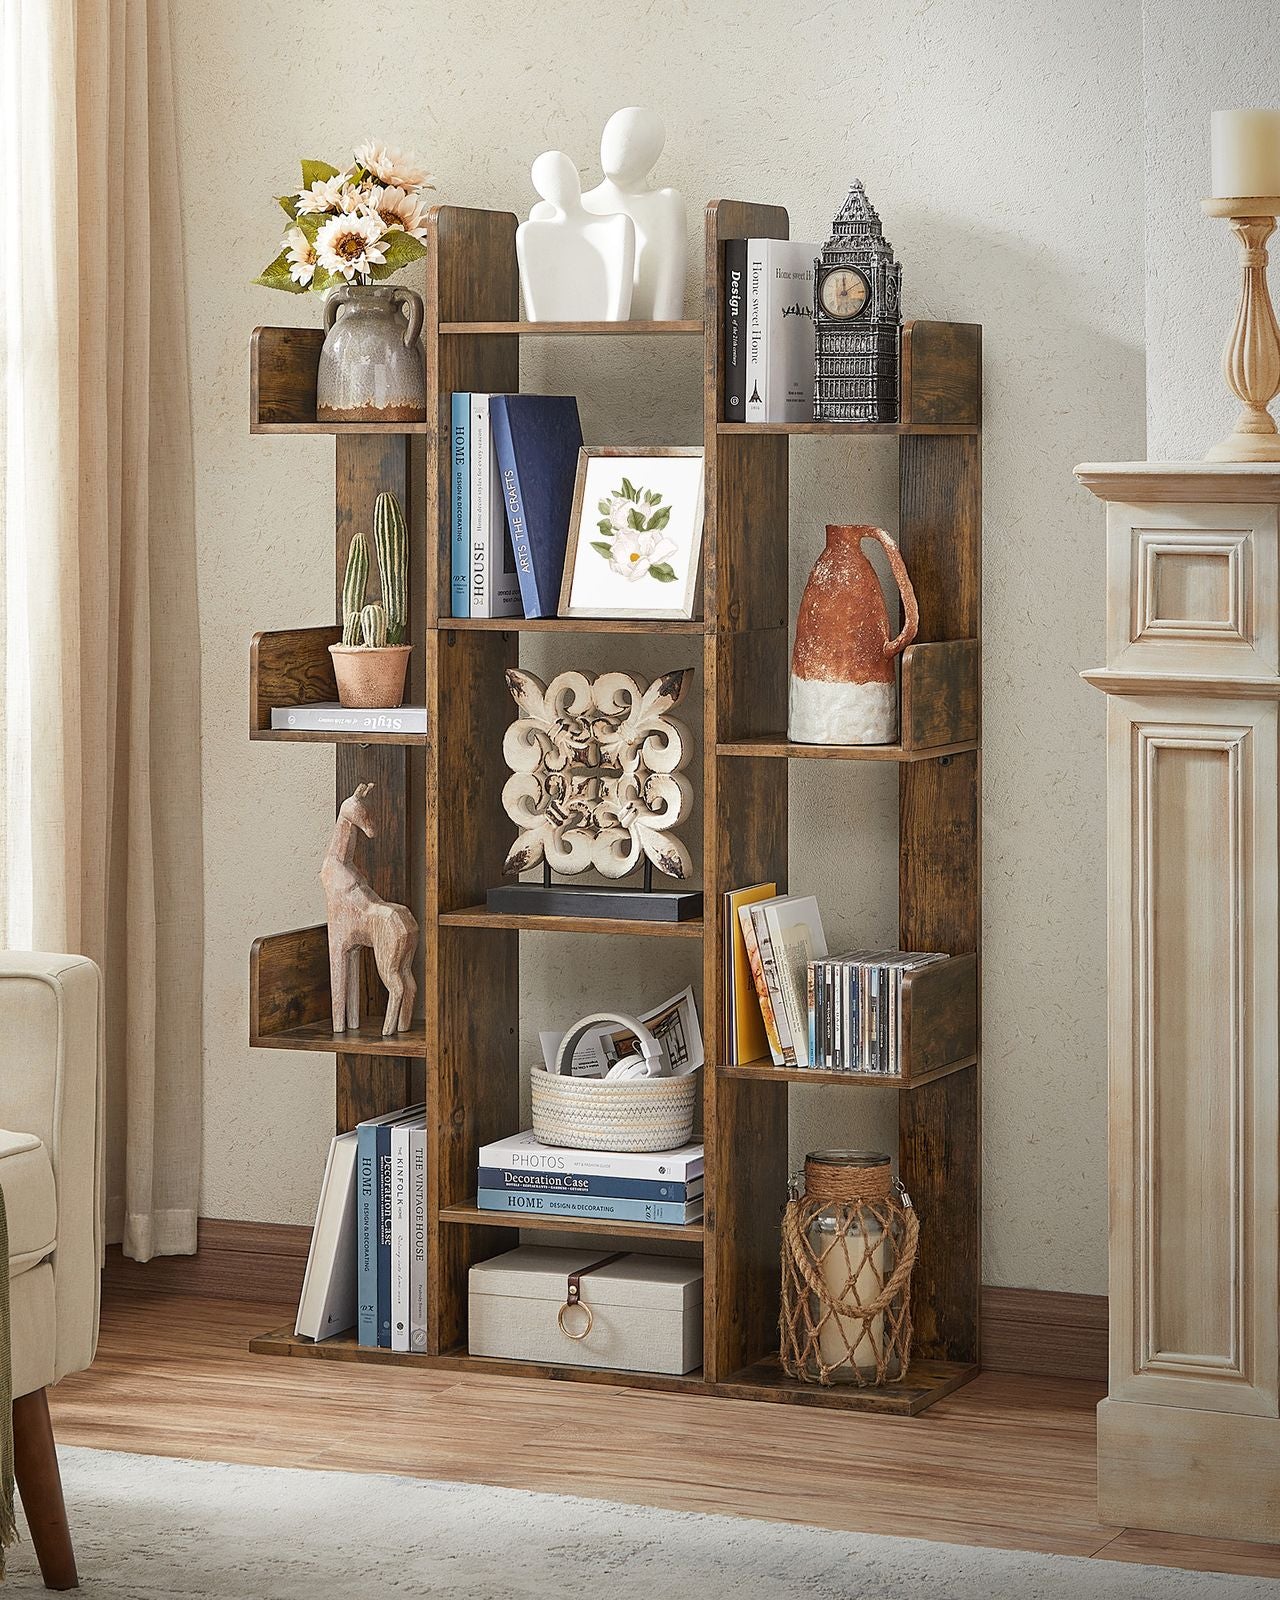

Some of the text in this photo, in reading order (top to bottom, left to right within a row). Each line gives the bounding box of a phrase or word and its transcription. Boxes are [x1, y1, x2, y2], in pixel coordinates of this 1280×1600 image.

[776, 268, 791, 279] Home
[728, 271, 741, 317] Design
[751, 262, 762, 364] Home sweet Home
[455, 426, 465, 466] HOME
[505, 470, 531, 574] ARTS THE CRAFTS
[473, 542, 485, 596] HOUSE
[364, 715, 402, 730] Style
[362, 1158, 372, 1197] HOME
[504, 1171, 589, 1188] Decoration Case
[512, 1153, 565, 1170] PHOTOS
[384, 1155, 392, 1246] Decoration Case
[415, 1148, 424, 1262] THE VINTAGE HOUSE
[508, 1196, 544, 1209] HOME
[577, 1204, 615, 1213] DECORATING
